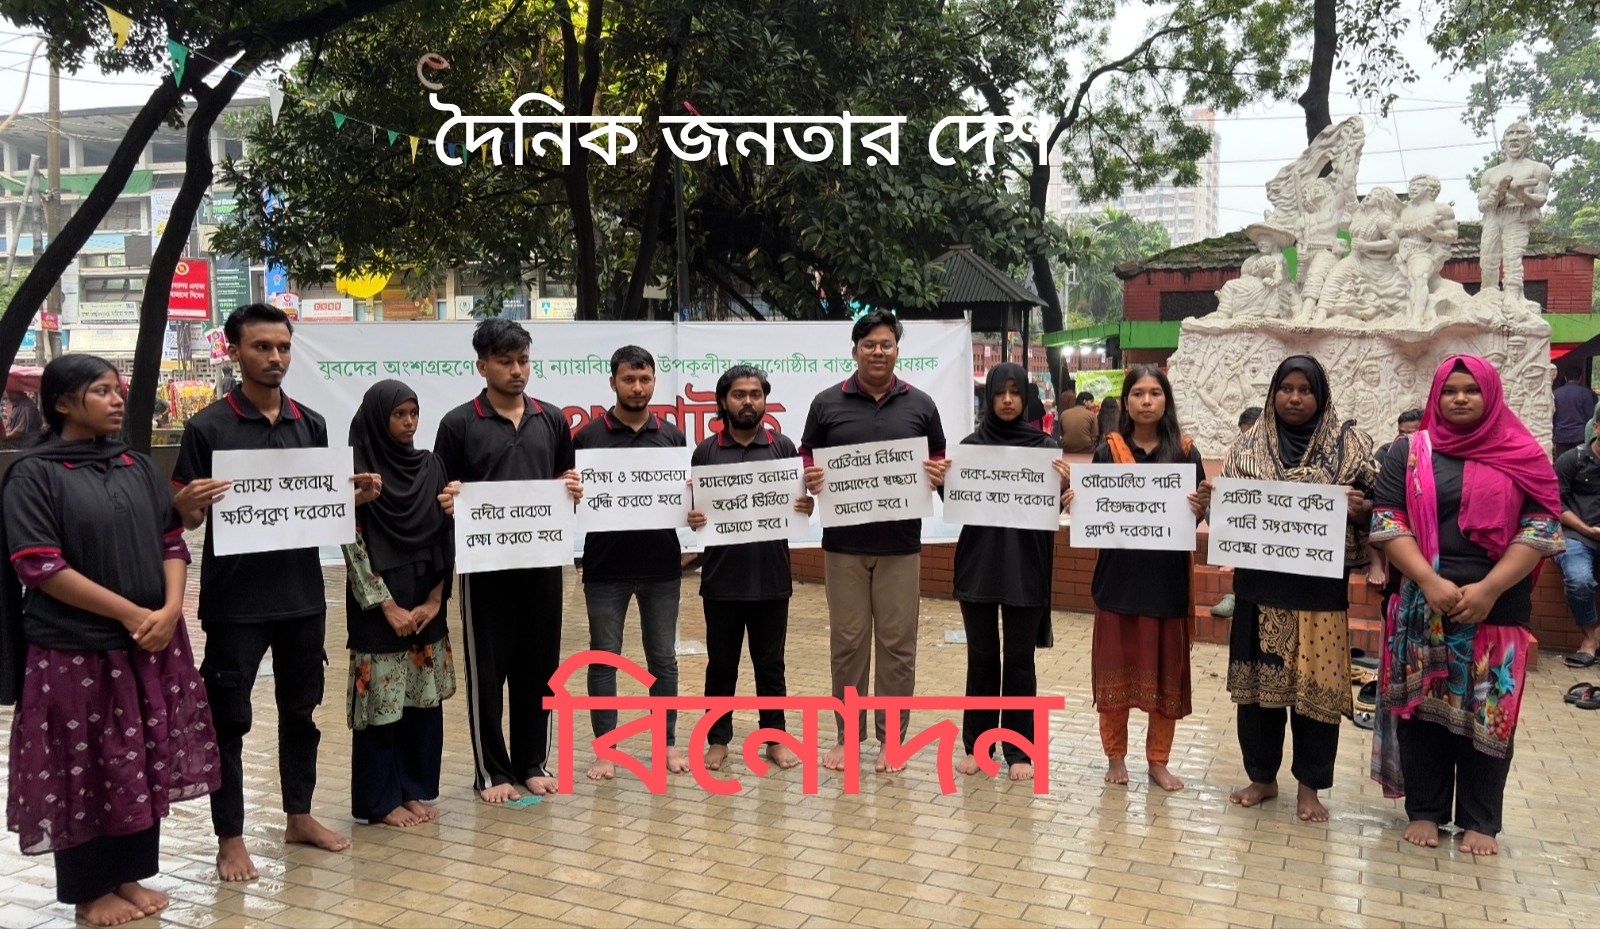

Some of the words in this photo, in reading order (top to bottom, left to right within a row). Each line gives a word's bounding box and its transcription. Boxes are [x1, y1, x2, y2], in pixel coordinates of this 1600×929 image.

[317, 360, 377, 381] যুবদের
[383, 359, 475, 376] অংশগ্রহণে
[549, 354, 612, 375] ন্যায়বিচ
[657, 353, 731, 378] উপকূলীয়
[822, 357, 859, 373] বাস্ত
[875, 448, 914, 465] নির্মাণে
[232, 478, 273, 494] ন্যায্য
[278, 475, 339, 492] জলবায়ু
[580, 468, 613, 484] শিক্ষা
[618, 471, 626, 483] ও
[757, 468, 799, 484] বনায়ন
[828, 476, 880, 493] আমাদের
[1081, 473, 1147, 489] সৌরচালিত
[1151, 473, 1183, 489] পানি
[586, 493, 613, 512] বৃদ্ধি
[617, 495, 653, 508] করতে
[657, 494, 682, 506] হবে
[712, 494, 748, 511] জরুরি
[751, 491, 790, 508] ভিত্তিতে
[949, 489, 982, 502] ধানের
[986, 491, 1011, 504] জাত
[1013, 493, 1056, 507] দরকার
[1095, 497, 1167, 514] বিশুদ্ধকরণ
[1222, 489, 1262, 505] প্রতিটি
[1266, 494, 1293, 509] ঘরে
[1297, 493, 1335, 513] বৃষ্টির
[220, 505, 289, 526] ক্ষতিপূরণ
[294, 503, 346, 520] দরকার
[471, 503, 505, 520] নদীর
[509, 505, 552, 518] নাব্যতা
[833, 500, 873, 515] আনতে
[1227, 514, 1257, 530] পানি
[1262, 518, 1328, 537] সংরক্ষণের
[466, 533, 492, 548] রক্ষা
[496, 531, 533, 545] করতে
[537, 529, 563, 542] হবে
[1218, 540, 1258, 555] ব্যবস্থা
[1261, 543, 1301, 559] করতে
[1305, 547, 1334, 562] হবে
